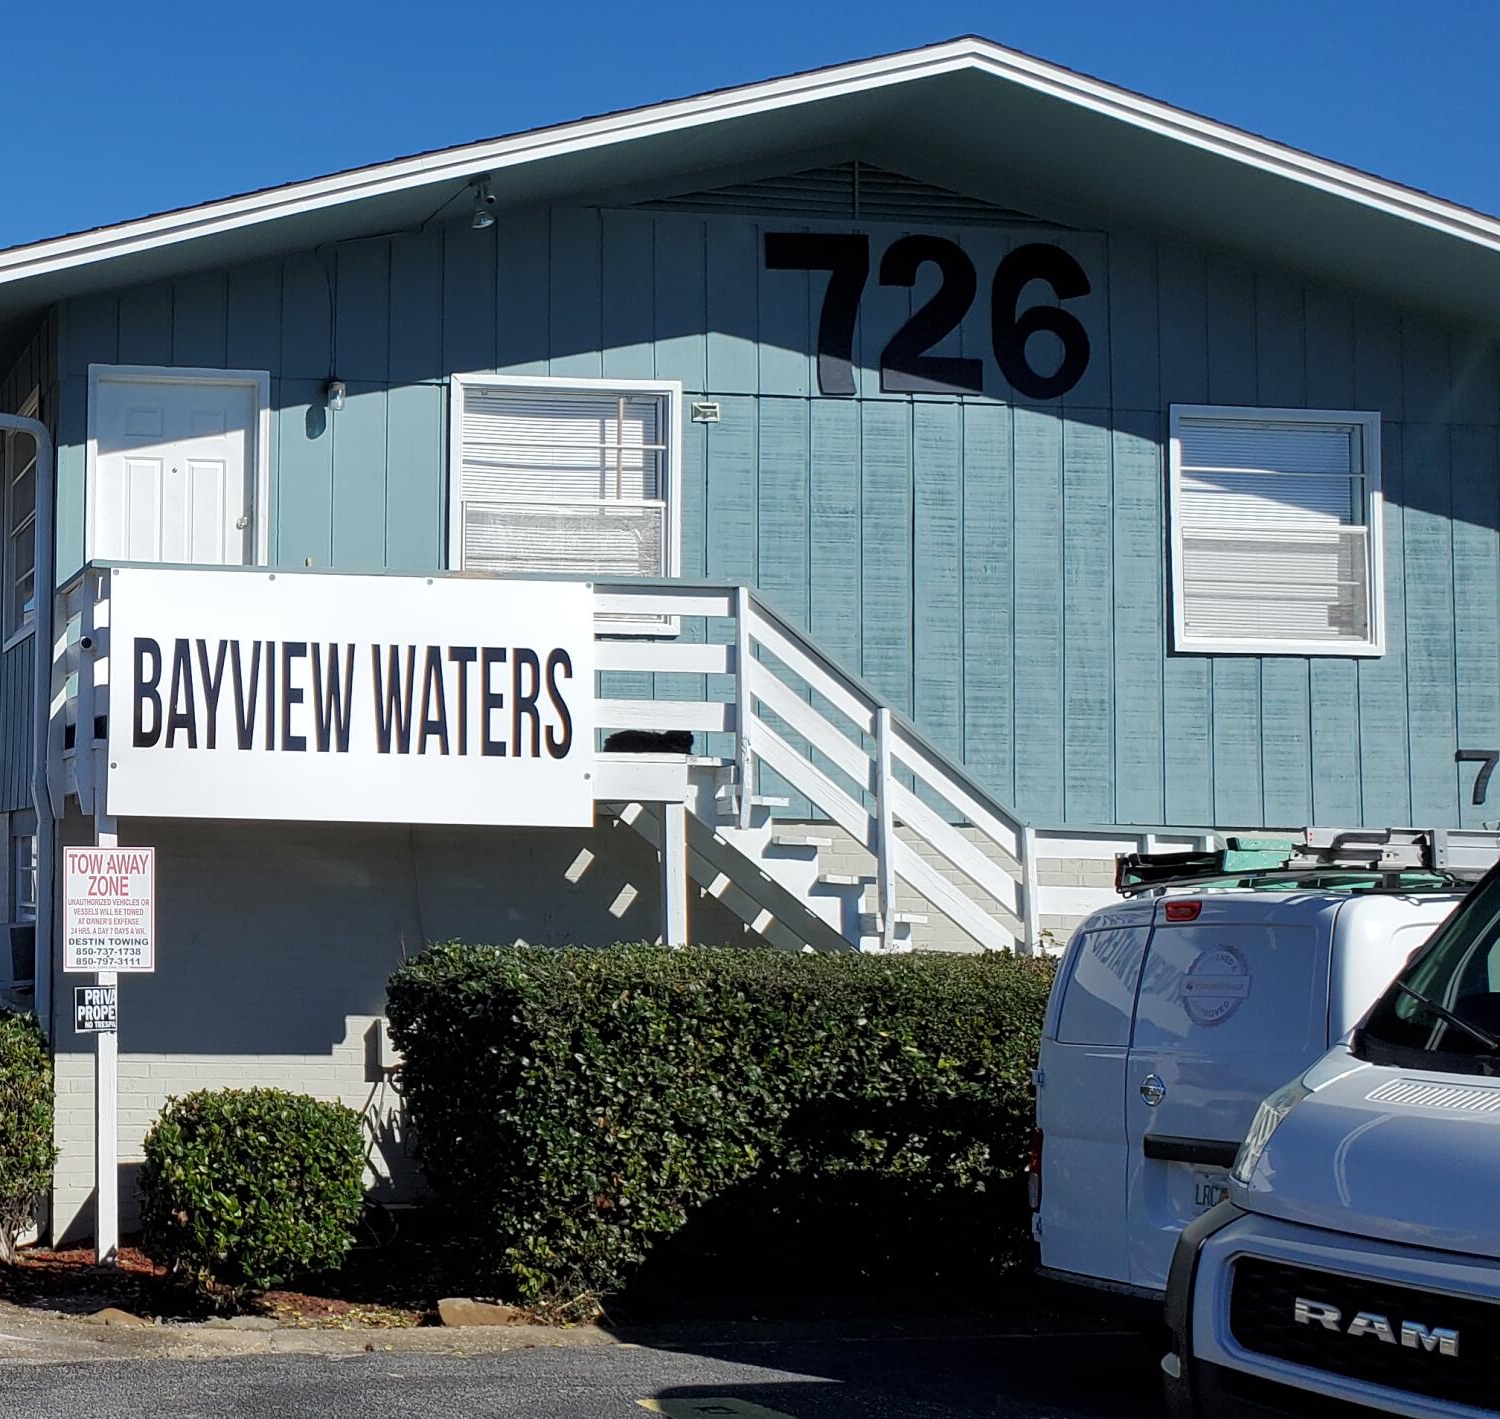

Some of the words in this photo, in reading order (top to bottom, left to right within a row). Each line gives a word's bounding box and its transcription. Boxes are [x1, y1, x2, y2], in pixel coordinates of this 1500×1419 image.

[764, 232, 1091, 400] 726
[133, 637, 355, 753] BAYVIEW
[371, 643, 573, 759] WATERS
[1455, 749, 1500, 805] 7
[69, 854, 103, 874] TOW
[106, 854, 149, 874] AWAY
[88, 876, 129, 896] ZONE
[68, 898, 111, 906] UNAUTHORIZED
[68, 938, 105, 946] DESTIN
[108, 938, 149, 946] TOWING
[75, 957, 141, 965] 850-797-3111
[1294, 1297, 1460, 1357] RAM
